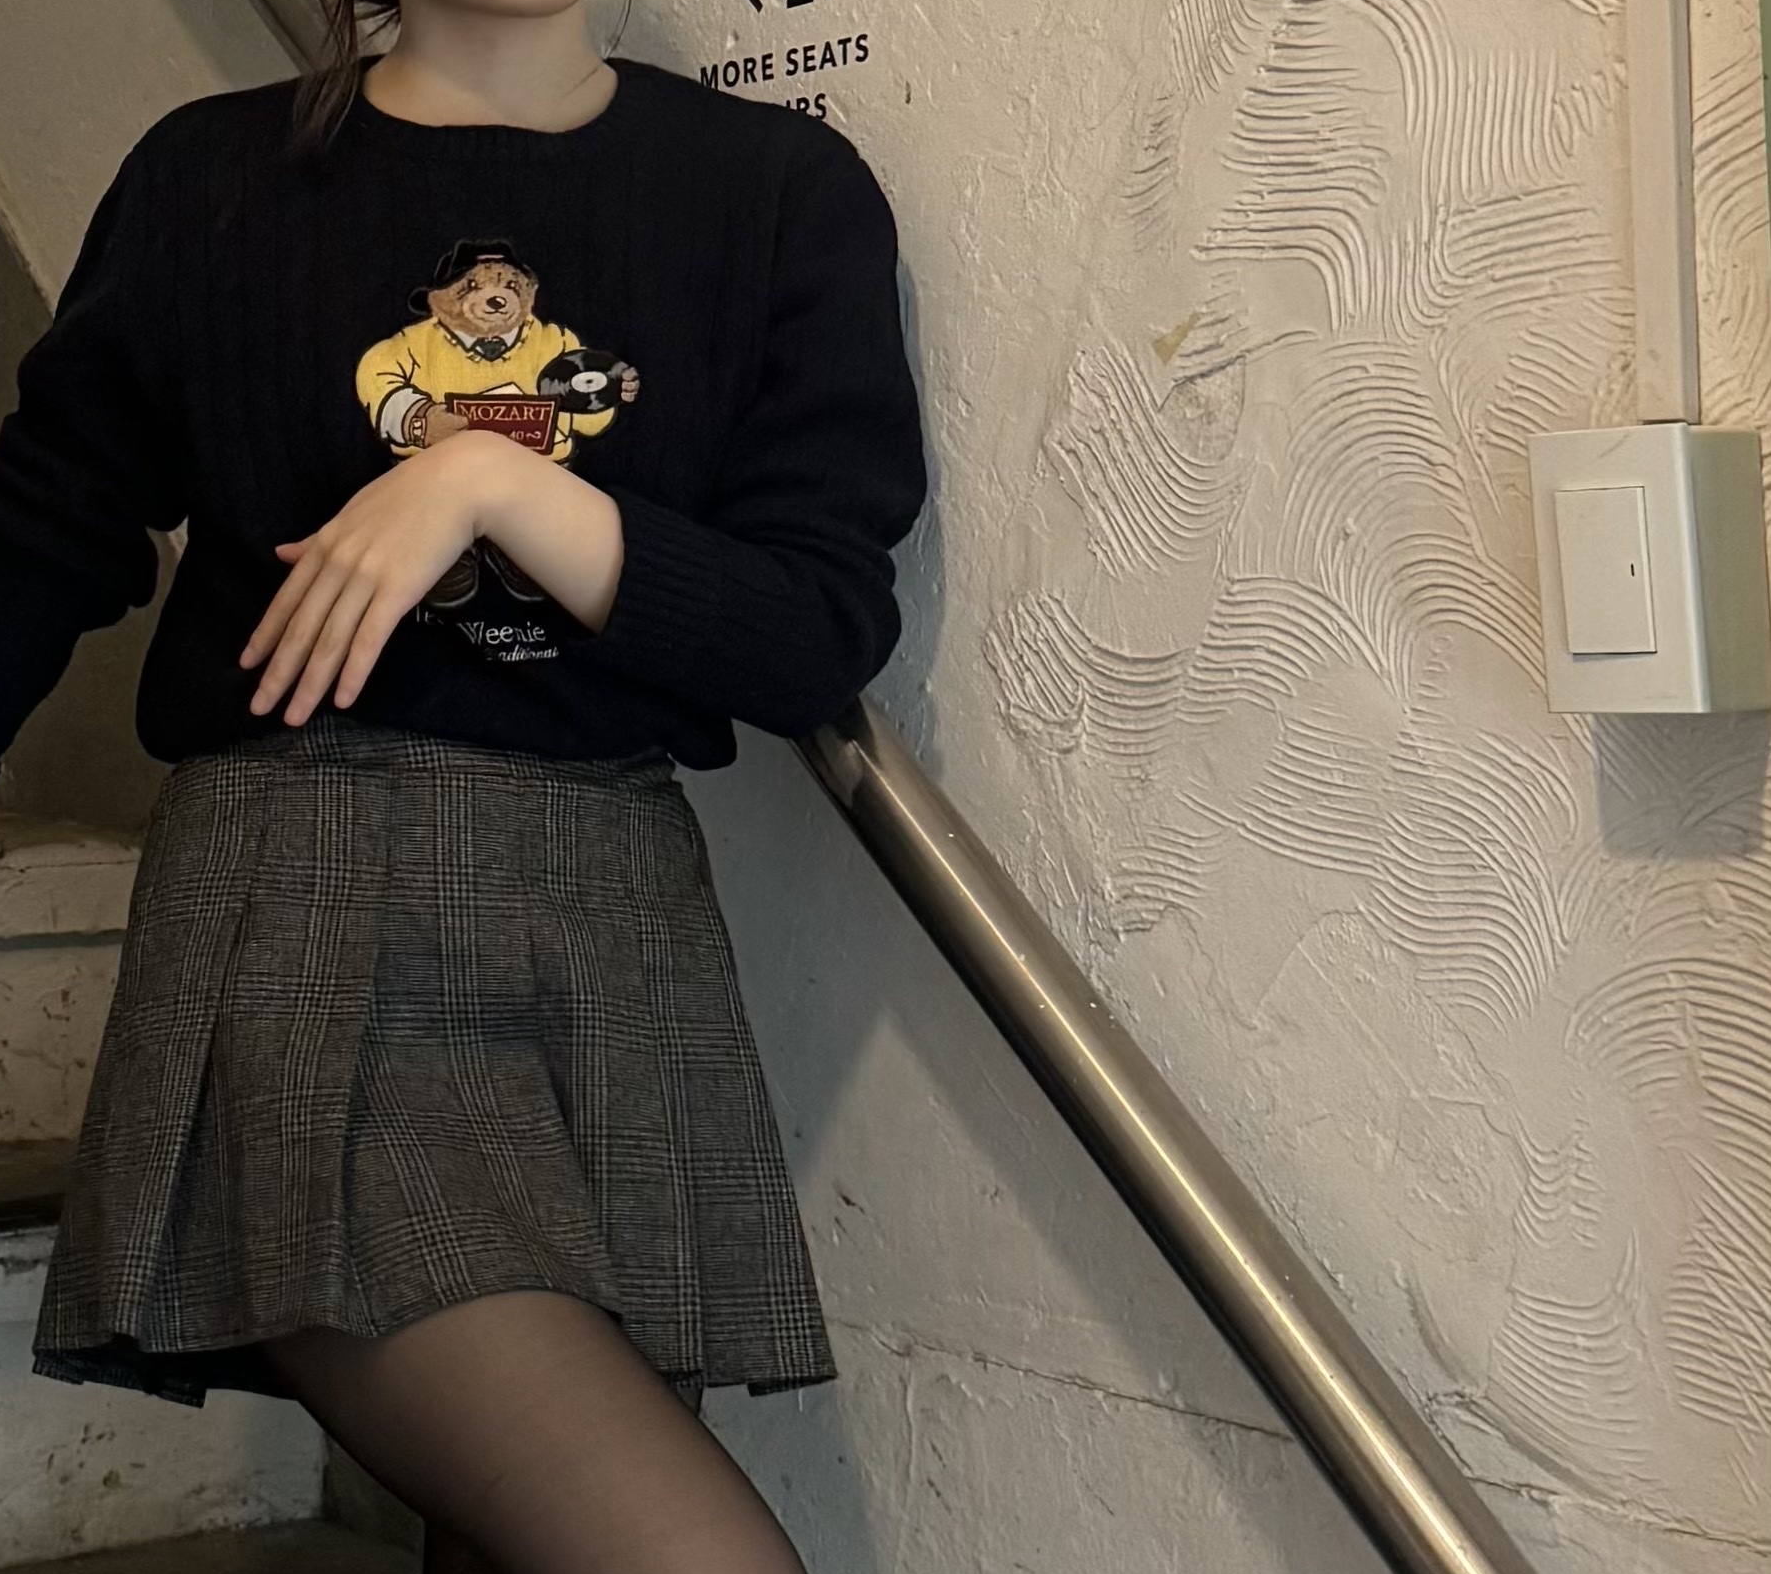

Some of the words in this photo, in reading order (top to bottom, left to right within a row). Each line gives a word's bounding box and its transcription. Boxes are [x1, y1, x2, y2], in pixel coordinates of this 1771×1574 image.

[700, 53, 775, 90] MORE
[785, 33, 869, 77] SEATS
[459, 404, 550, 421] MOZART
[457, 621, 546, 645] Weenie
